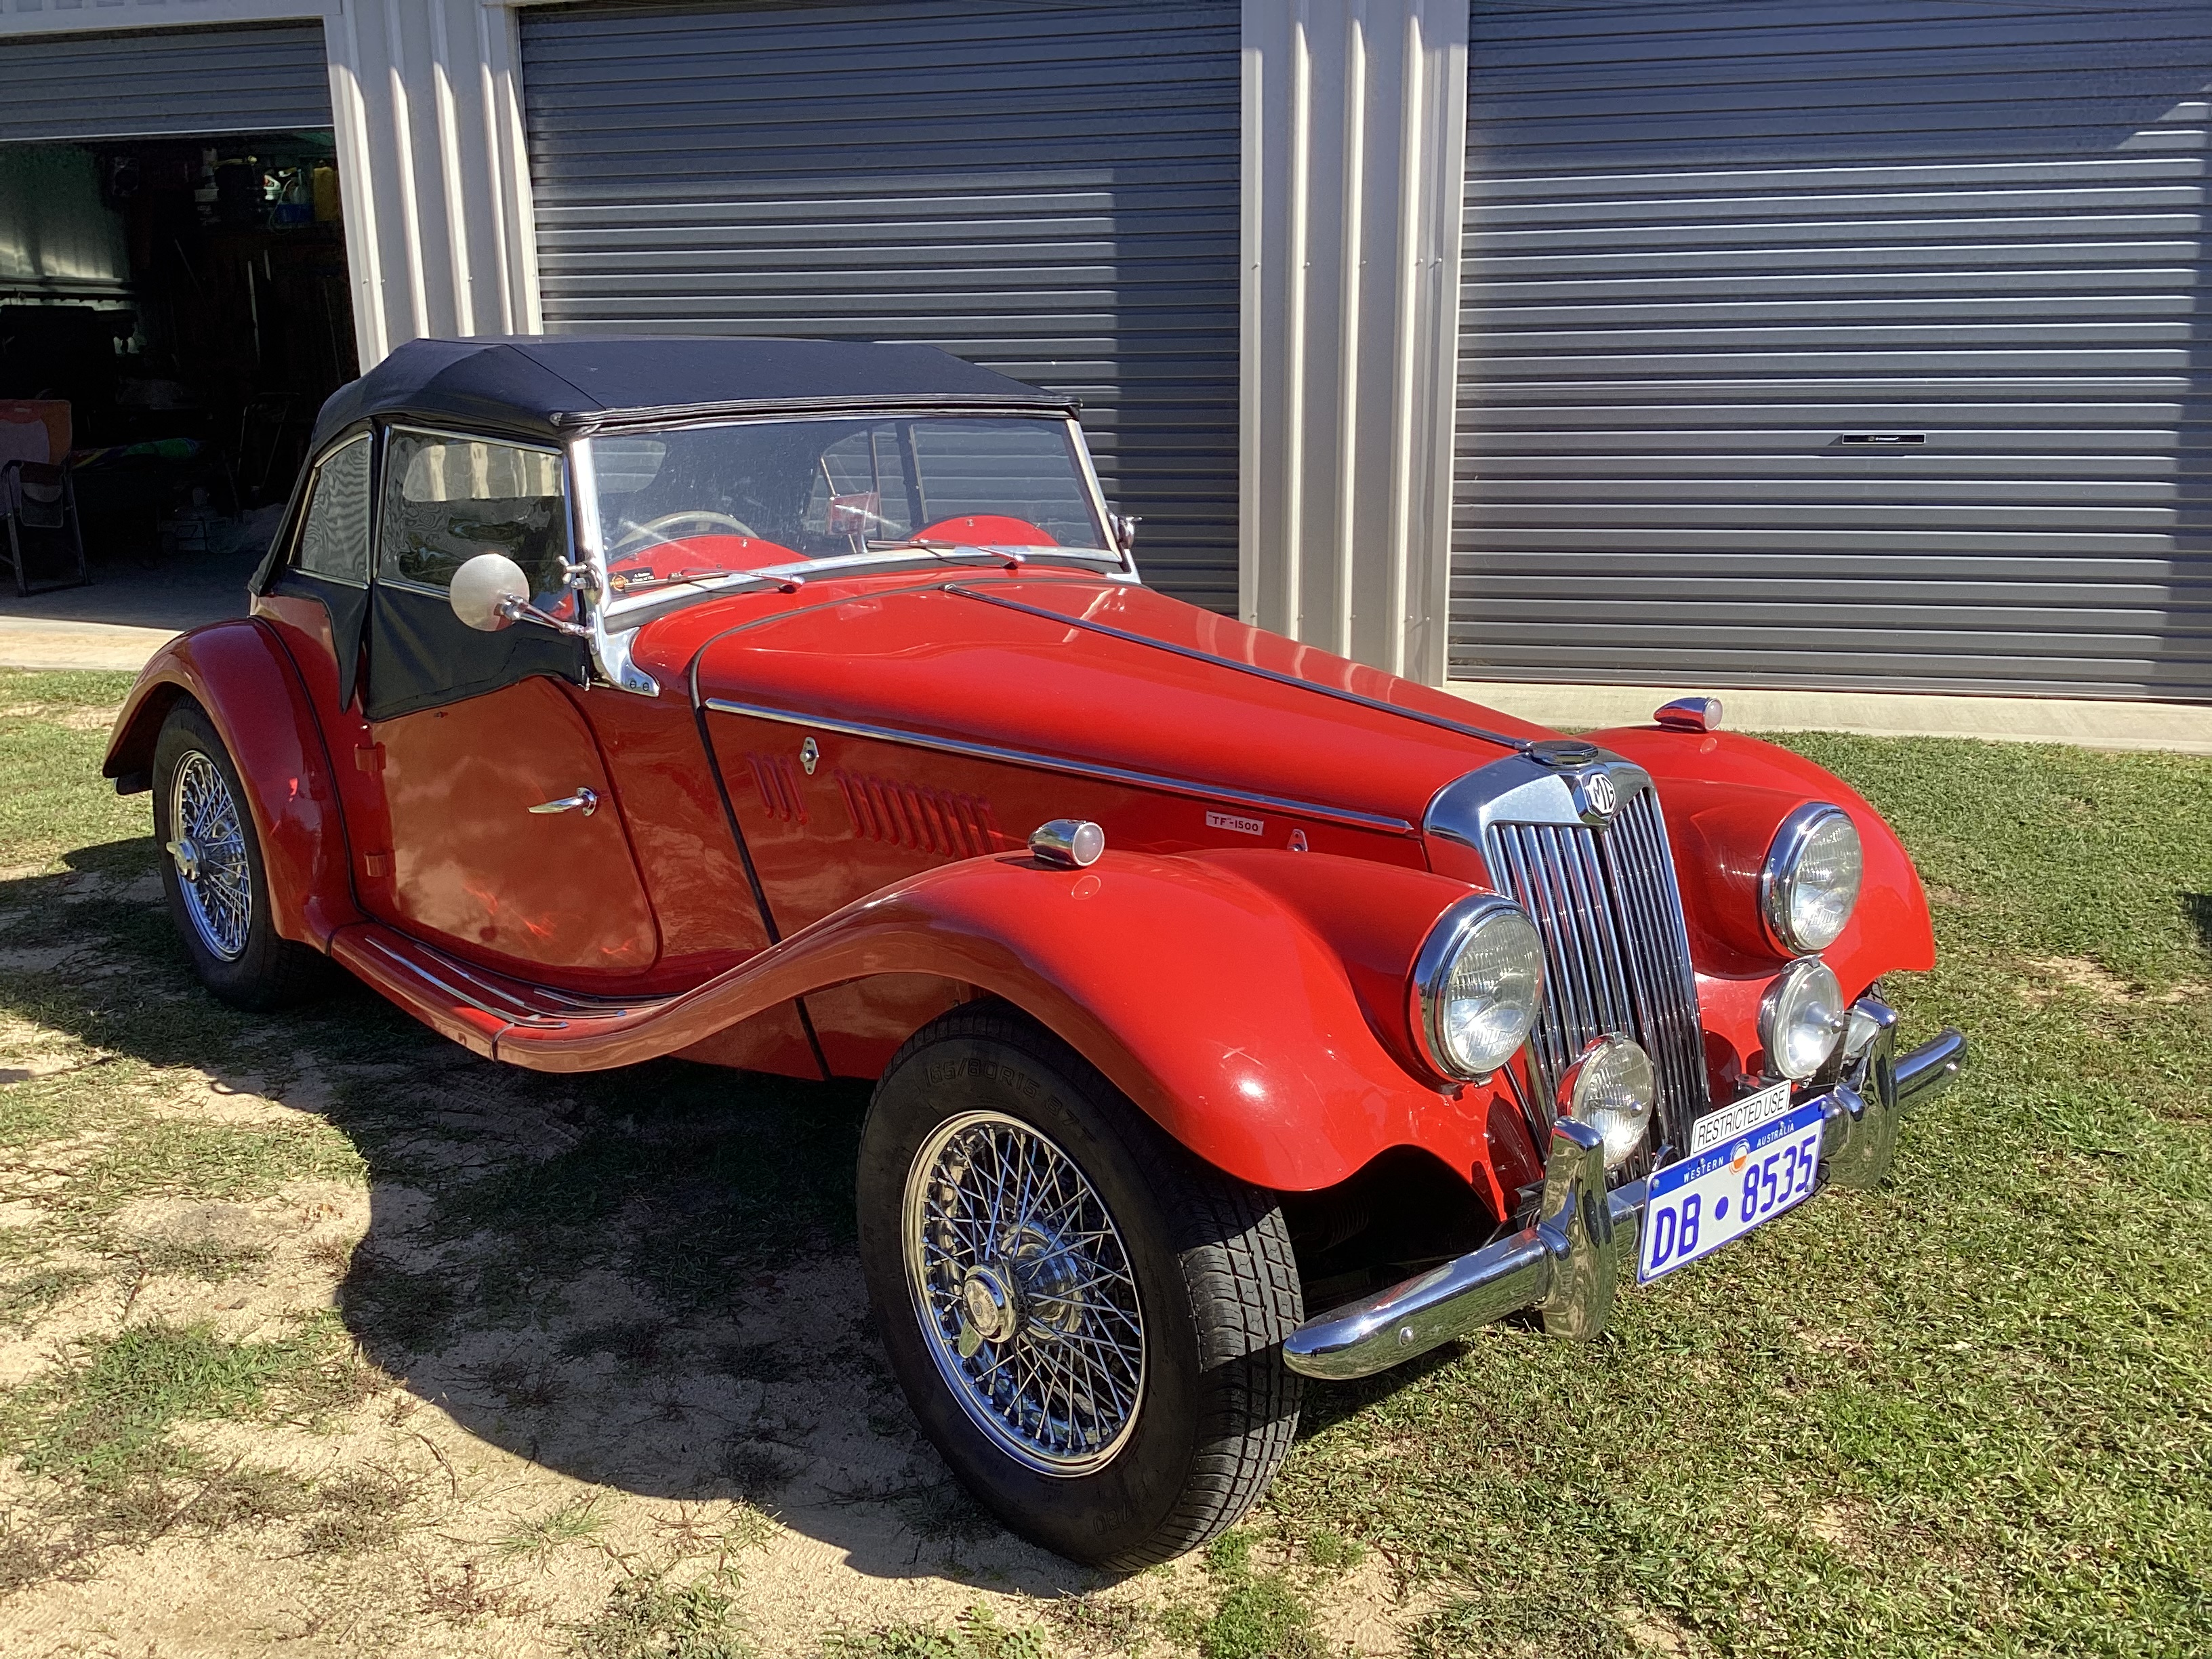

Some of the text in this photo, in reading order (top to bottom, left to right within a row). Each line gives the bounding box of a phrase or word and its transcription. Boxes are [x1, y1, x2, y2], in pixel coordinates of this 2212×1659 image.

[1592, 776, 1616, 811] MG
[1697, 1089, 1786, 1147] RESTRICTED USE
[1683, 1123, 1795, 1183] WESTERN AUSTRALIA
[1650, 1134, 1818, 1270] DB 8535
